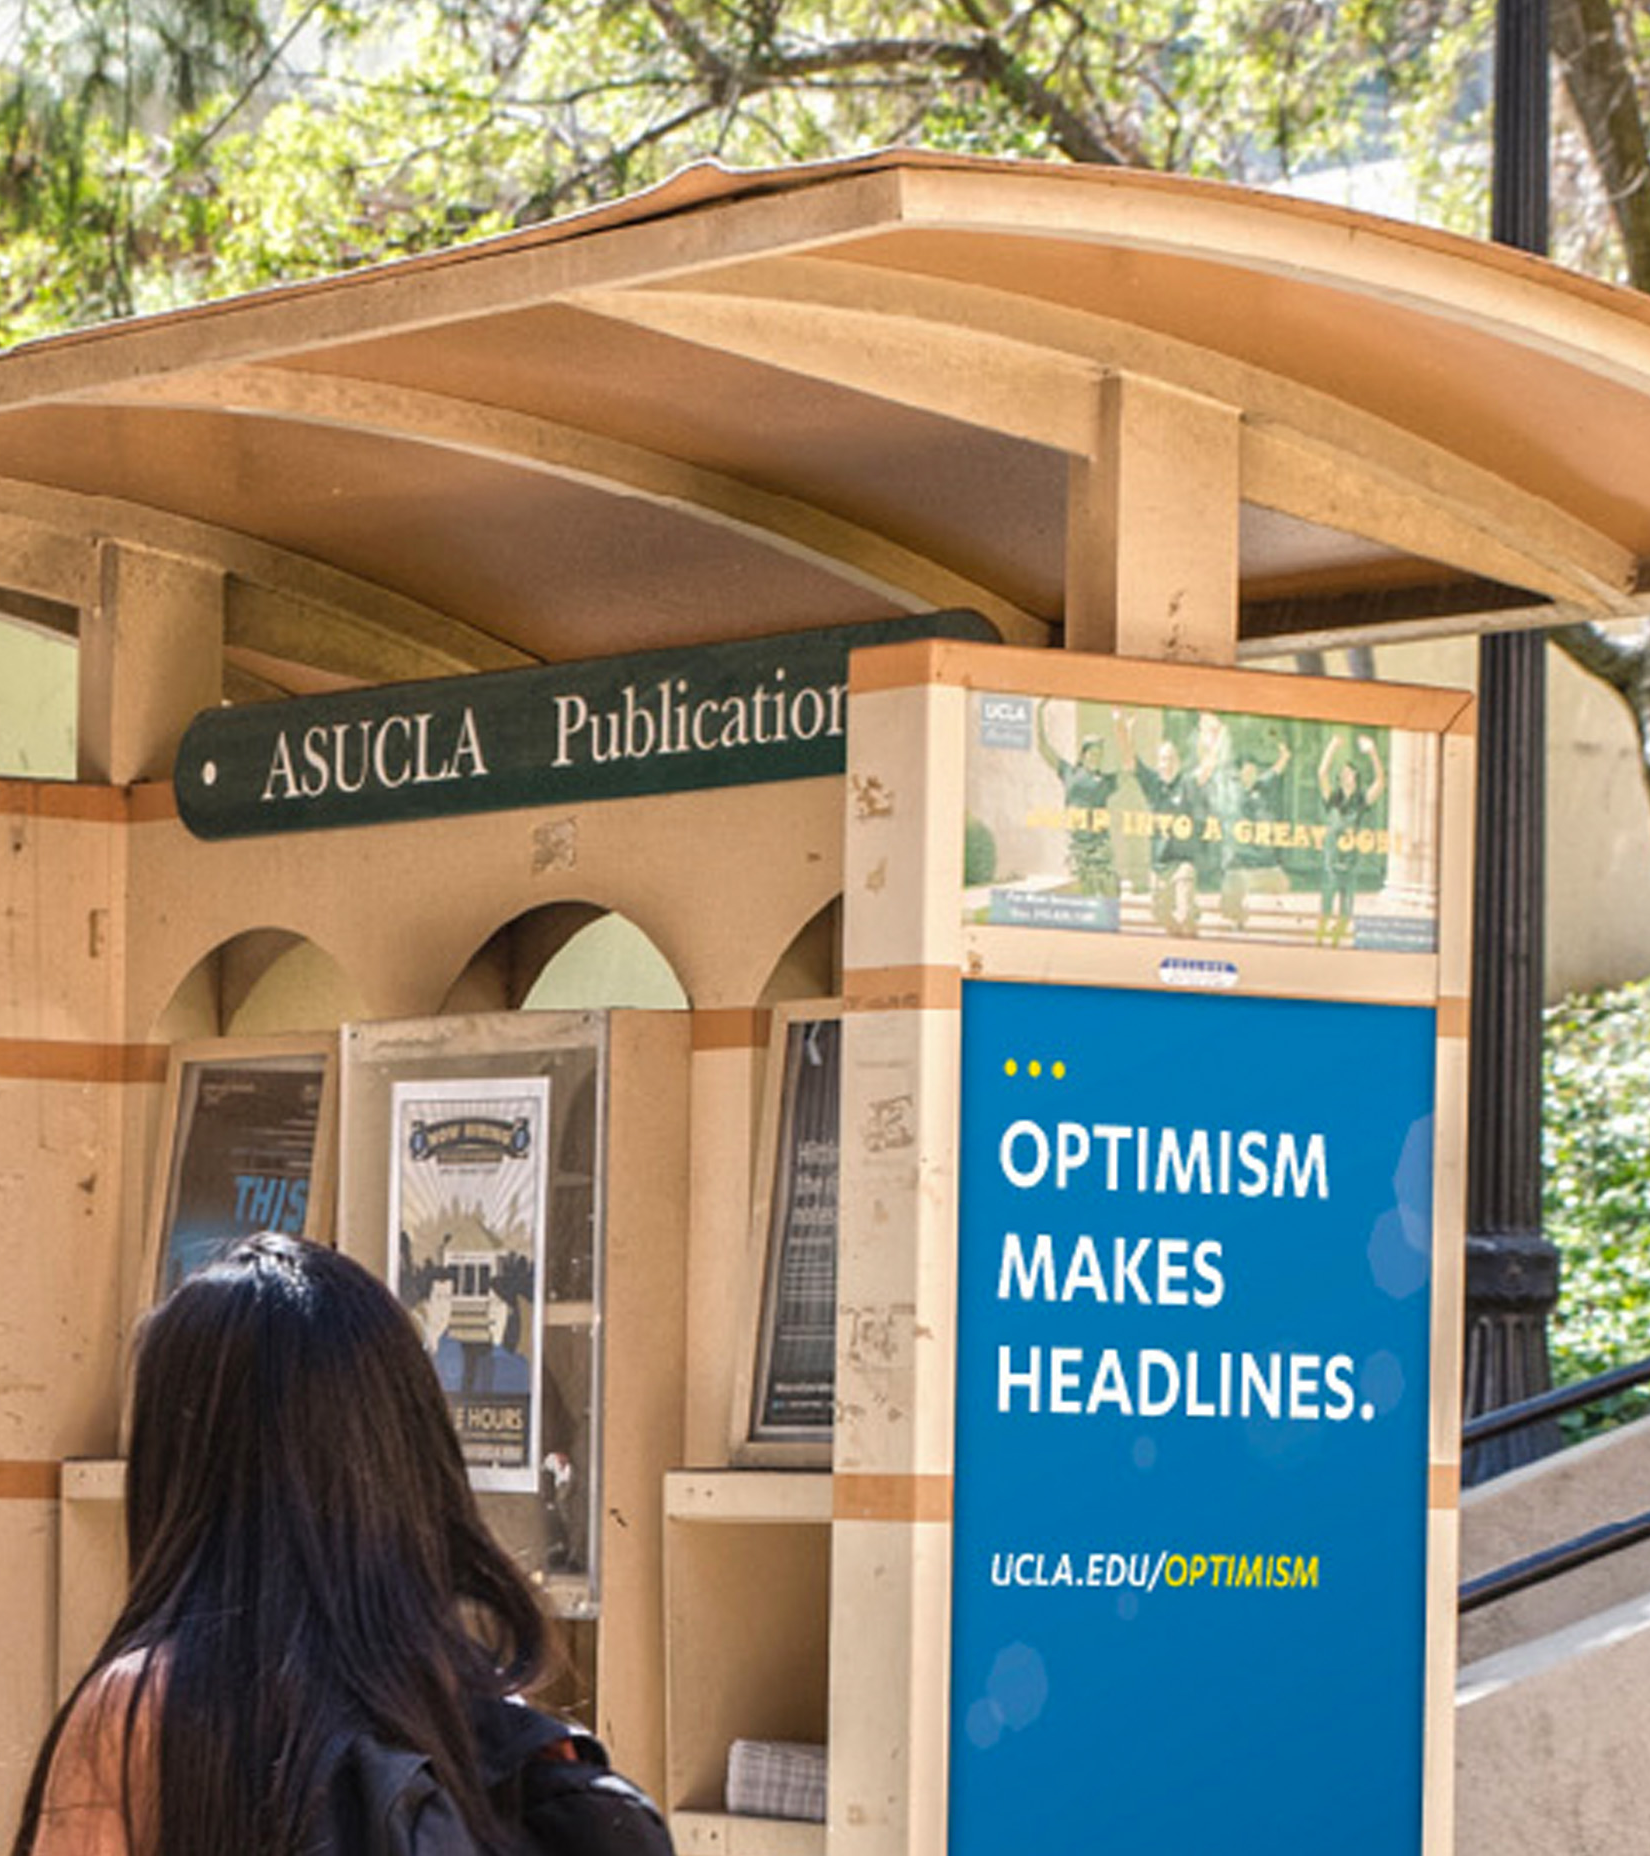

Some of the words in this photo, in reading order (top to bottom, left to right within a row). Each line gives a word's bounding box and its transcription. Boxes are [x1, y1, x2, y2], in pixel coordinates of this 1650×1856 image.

[261, 706, 489, 801] ASUCLA
[1122, 810, 1192, 842] INTO
[1202, 815, 1223, 842] A
[1234, 820, 1327, 850] GREAT
[999, 1119, 1329, 1200] OPTIMISM
[997, 1232, 1225, 1308] MAKES
[468, 1407, 524, 1431] HOURS
[997, 1345, 1376, 1421] HEADLINES.
[991, 1551, 1319, 1592] UCLA.EDU/OPTIMISM
